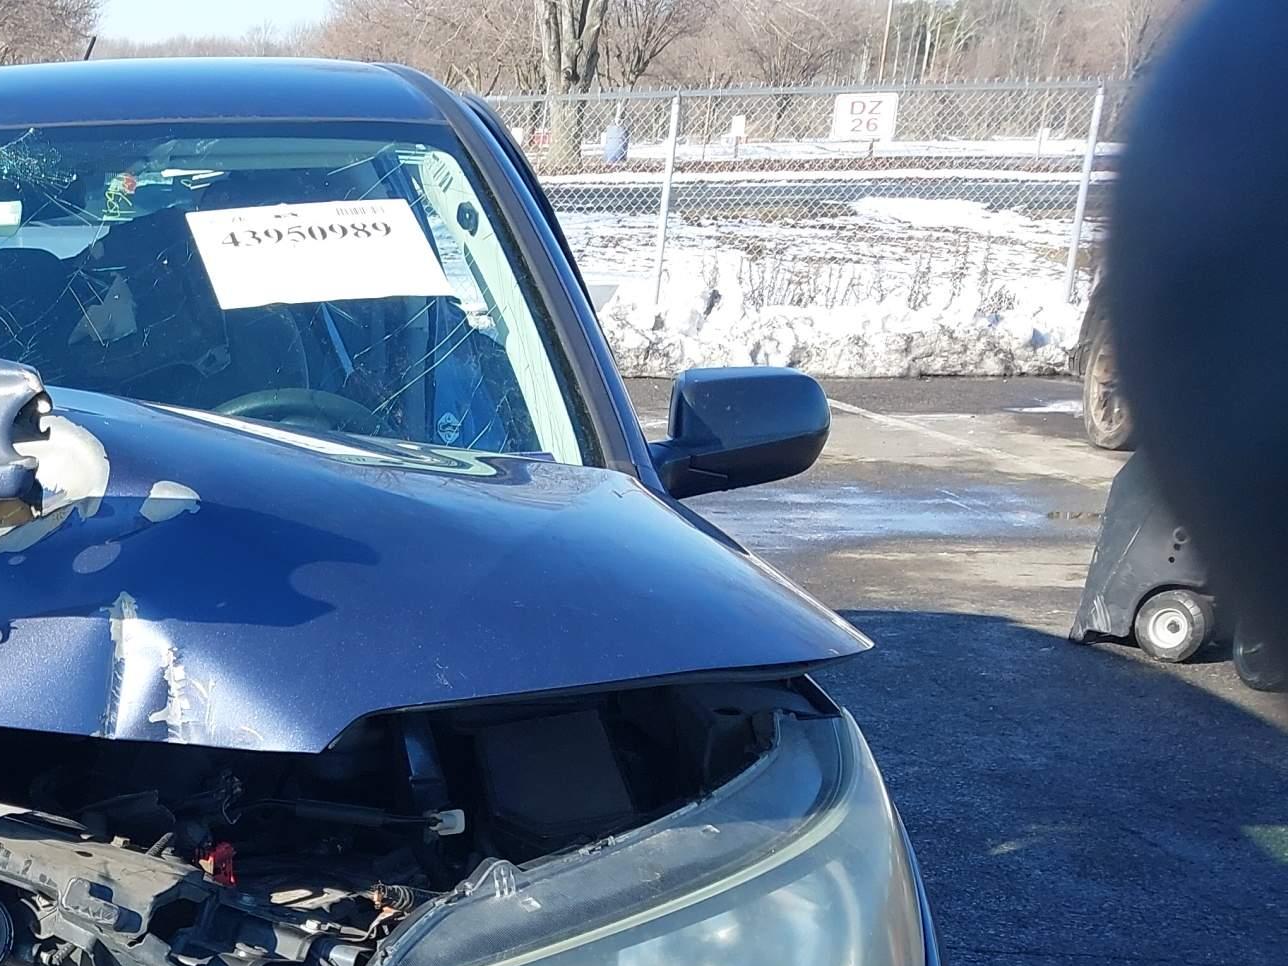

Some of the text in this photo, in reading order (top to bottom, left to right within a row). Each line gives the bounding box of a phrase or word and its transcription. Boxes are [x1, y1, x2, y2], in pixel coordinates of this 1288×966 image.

[850, 100, 883, 115] DZ
[850, 118, 879, 132] 26
[221, 221, 393, 248] 43950989
